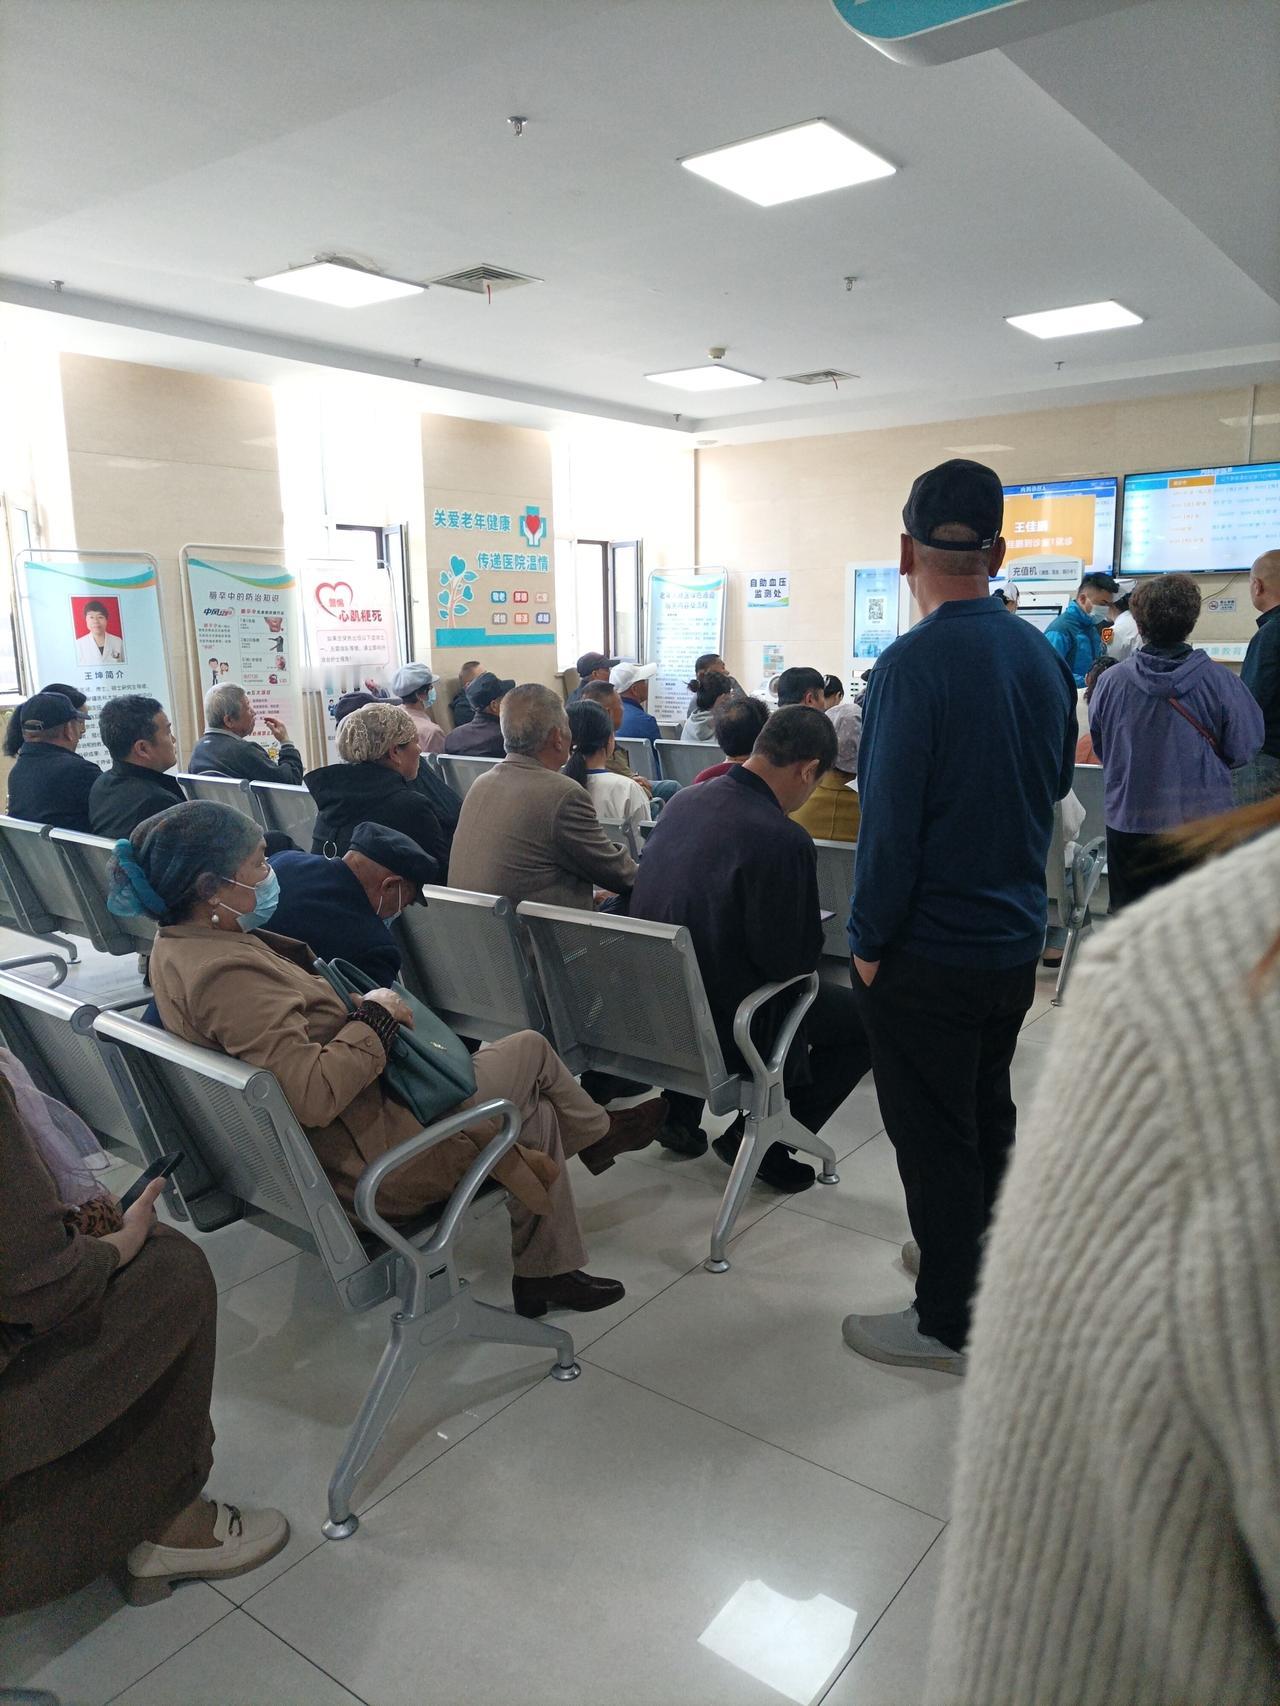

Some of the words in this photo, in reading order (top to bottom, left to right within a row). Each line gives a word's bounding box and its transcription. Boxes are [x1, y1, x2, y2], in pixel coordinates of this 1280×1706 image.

[434, 509, 512, 531] 关爱老年健康
[477, 553, 549, 572] 传递医院温情
[1013, 566, 1037, 577] 充值机
[750, 577, 787, 588] 自助血压
[208, 591, 279, 602] 脑卒中的防治知识
[754, 588, 782, 599] 监测处
[339, 609, 383, 622] 心肌梗死
